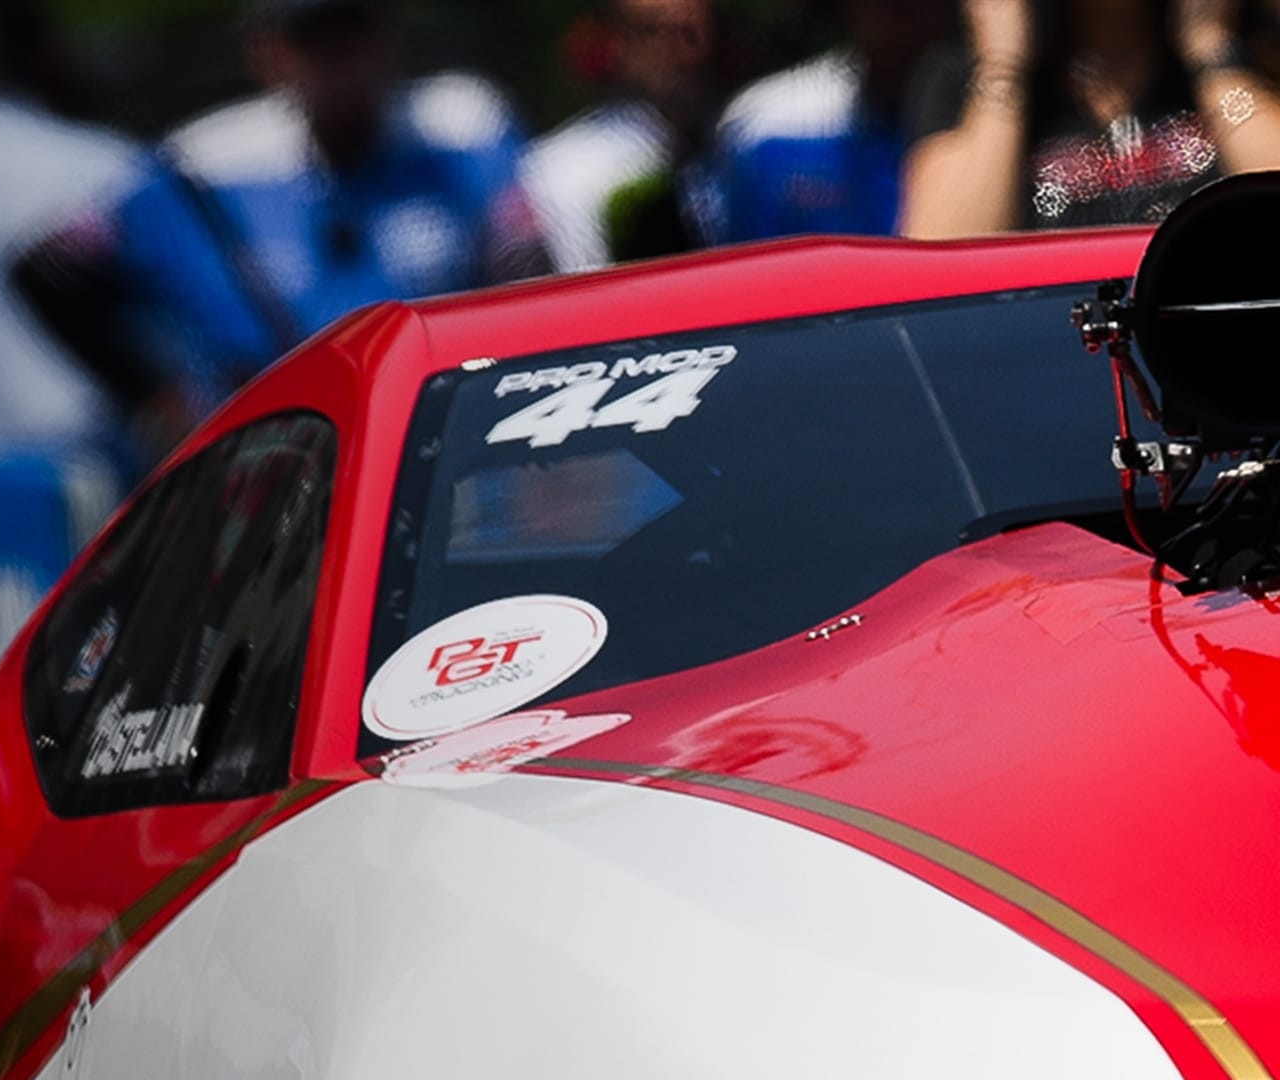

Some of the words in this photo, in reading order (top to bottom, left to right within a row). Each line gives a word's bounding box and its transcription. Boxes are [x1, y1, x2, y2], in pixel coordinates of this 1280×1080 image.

[494, 361, 607, 398] PRO
[609, 345, 738, 379] MOD
[484, 366, 720, 449] 44
